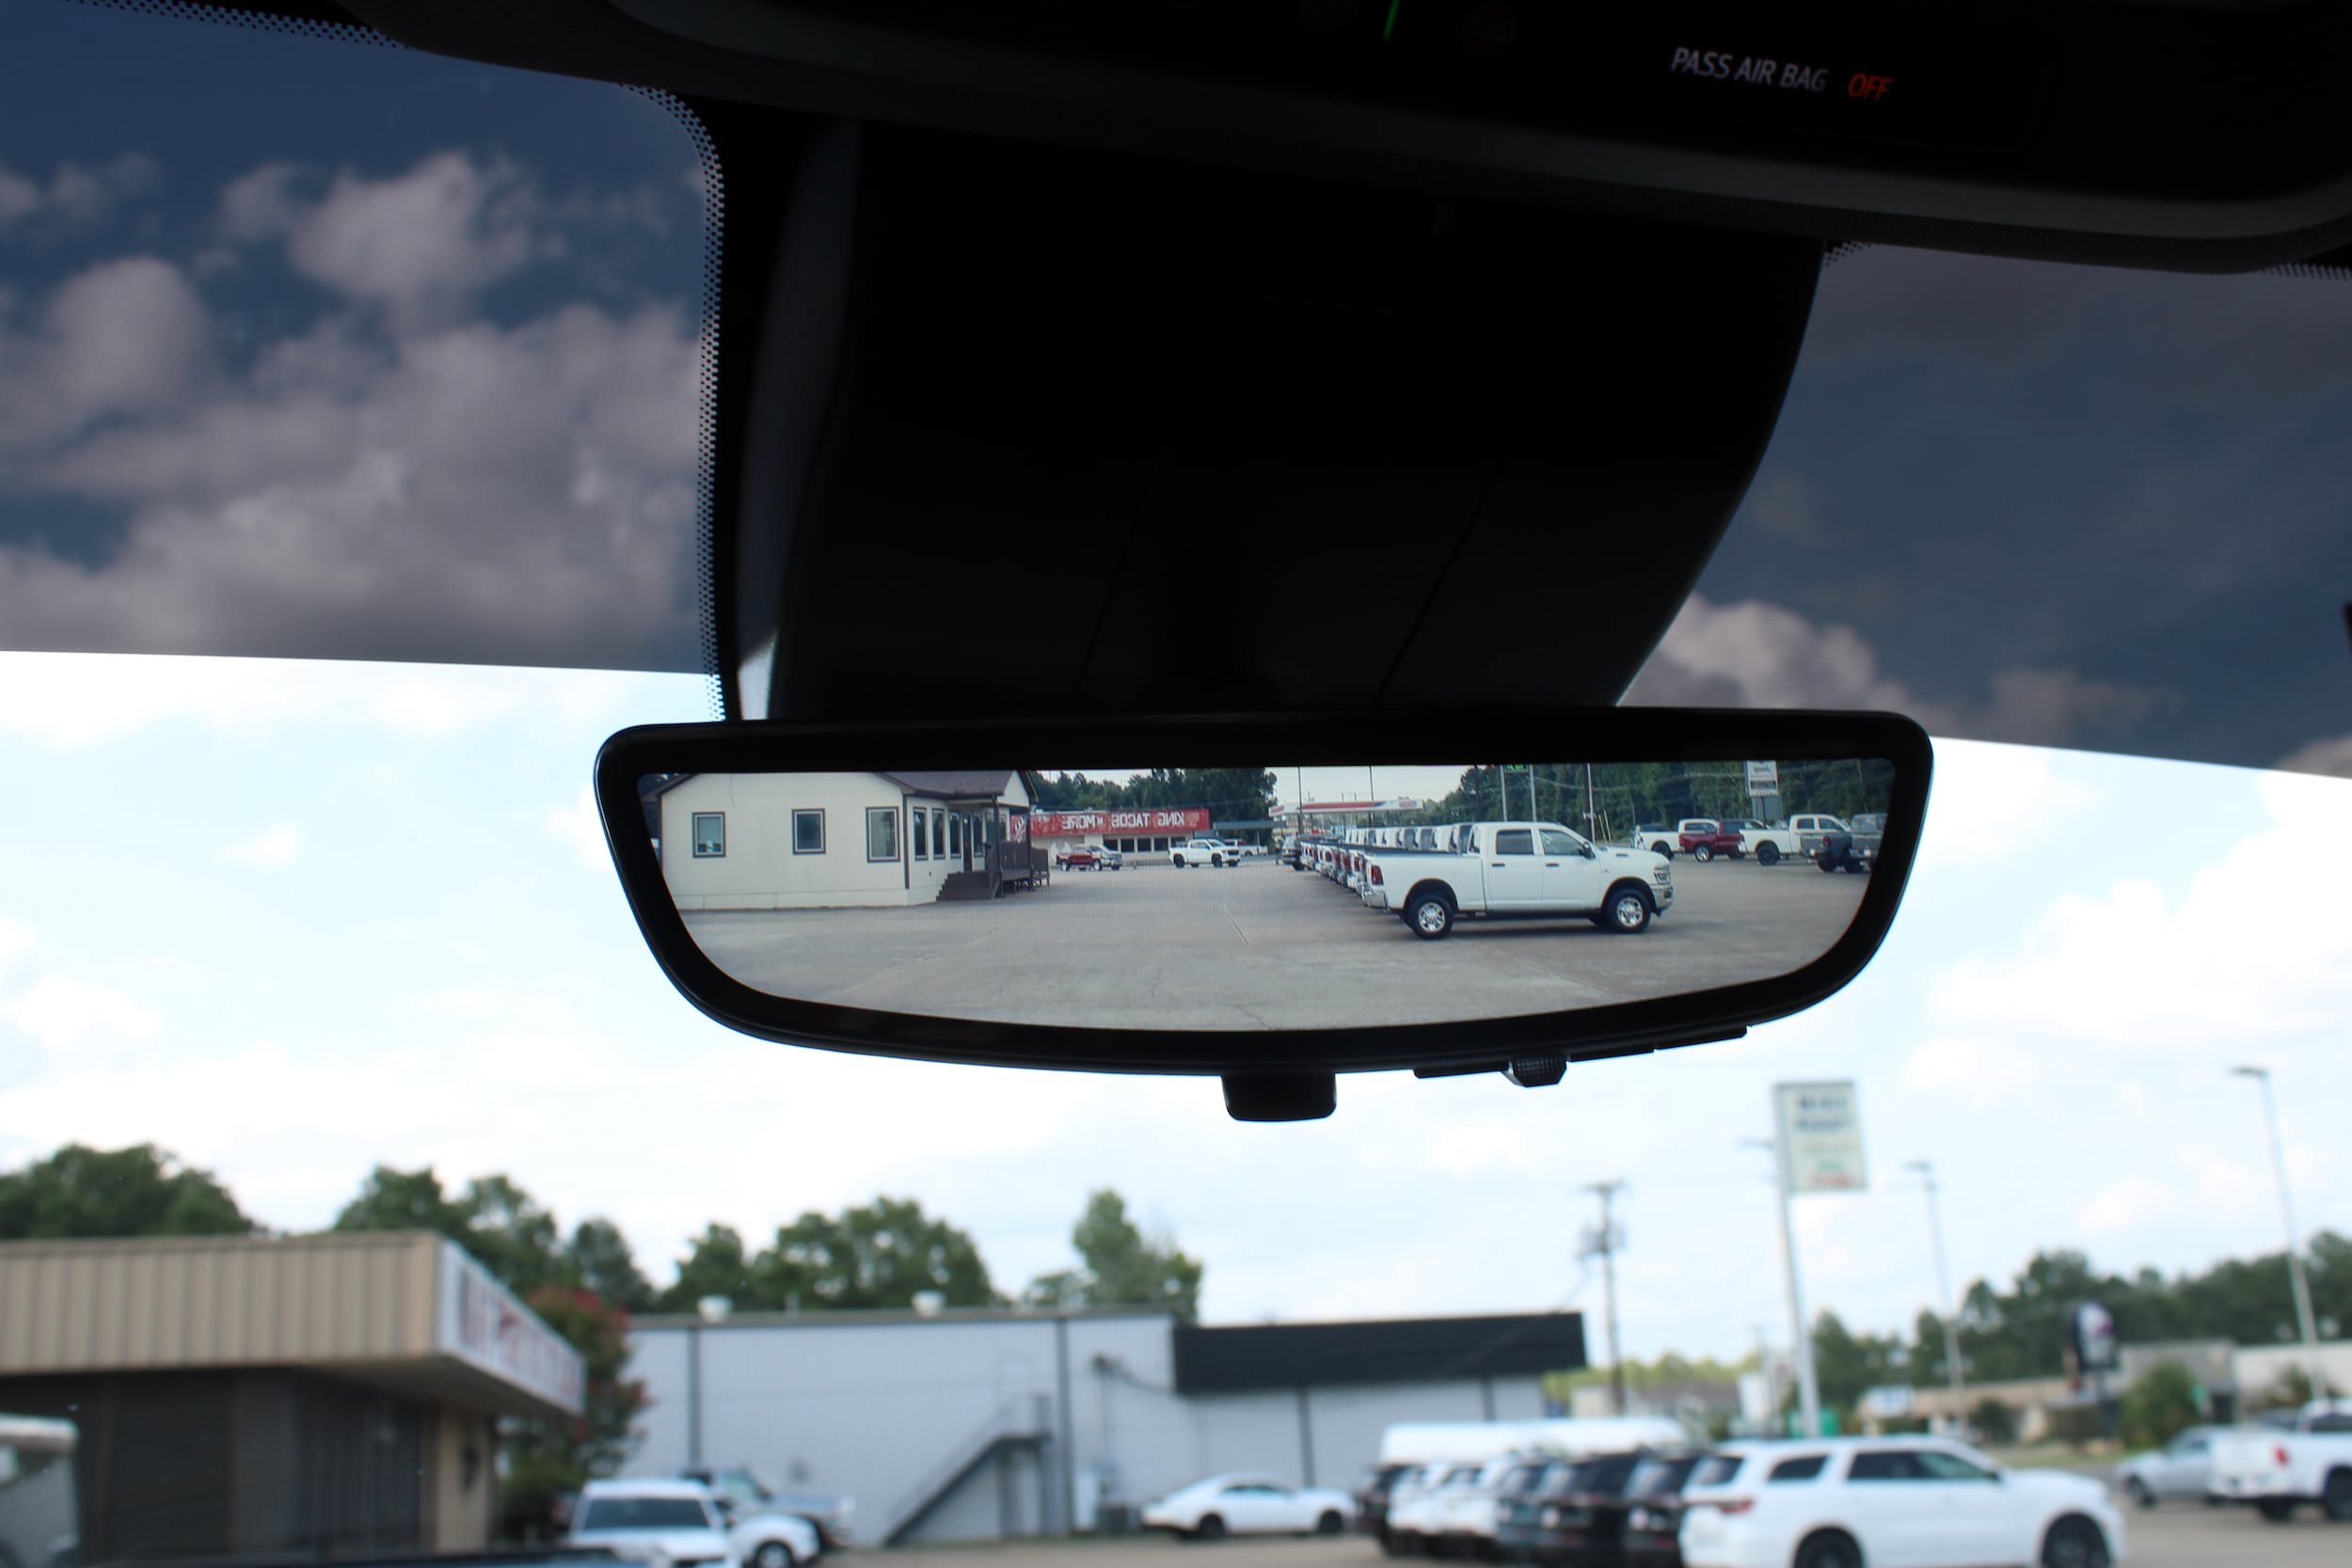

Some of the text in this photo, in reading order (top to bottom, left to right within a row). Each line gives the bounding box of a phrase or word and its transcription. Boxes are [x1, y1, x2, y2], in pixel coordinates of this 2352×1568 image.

[1672, 47, 1893, 101] PASS AIR BAG OFF
